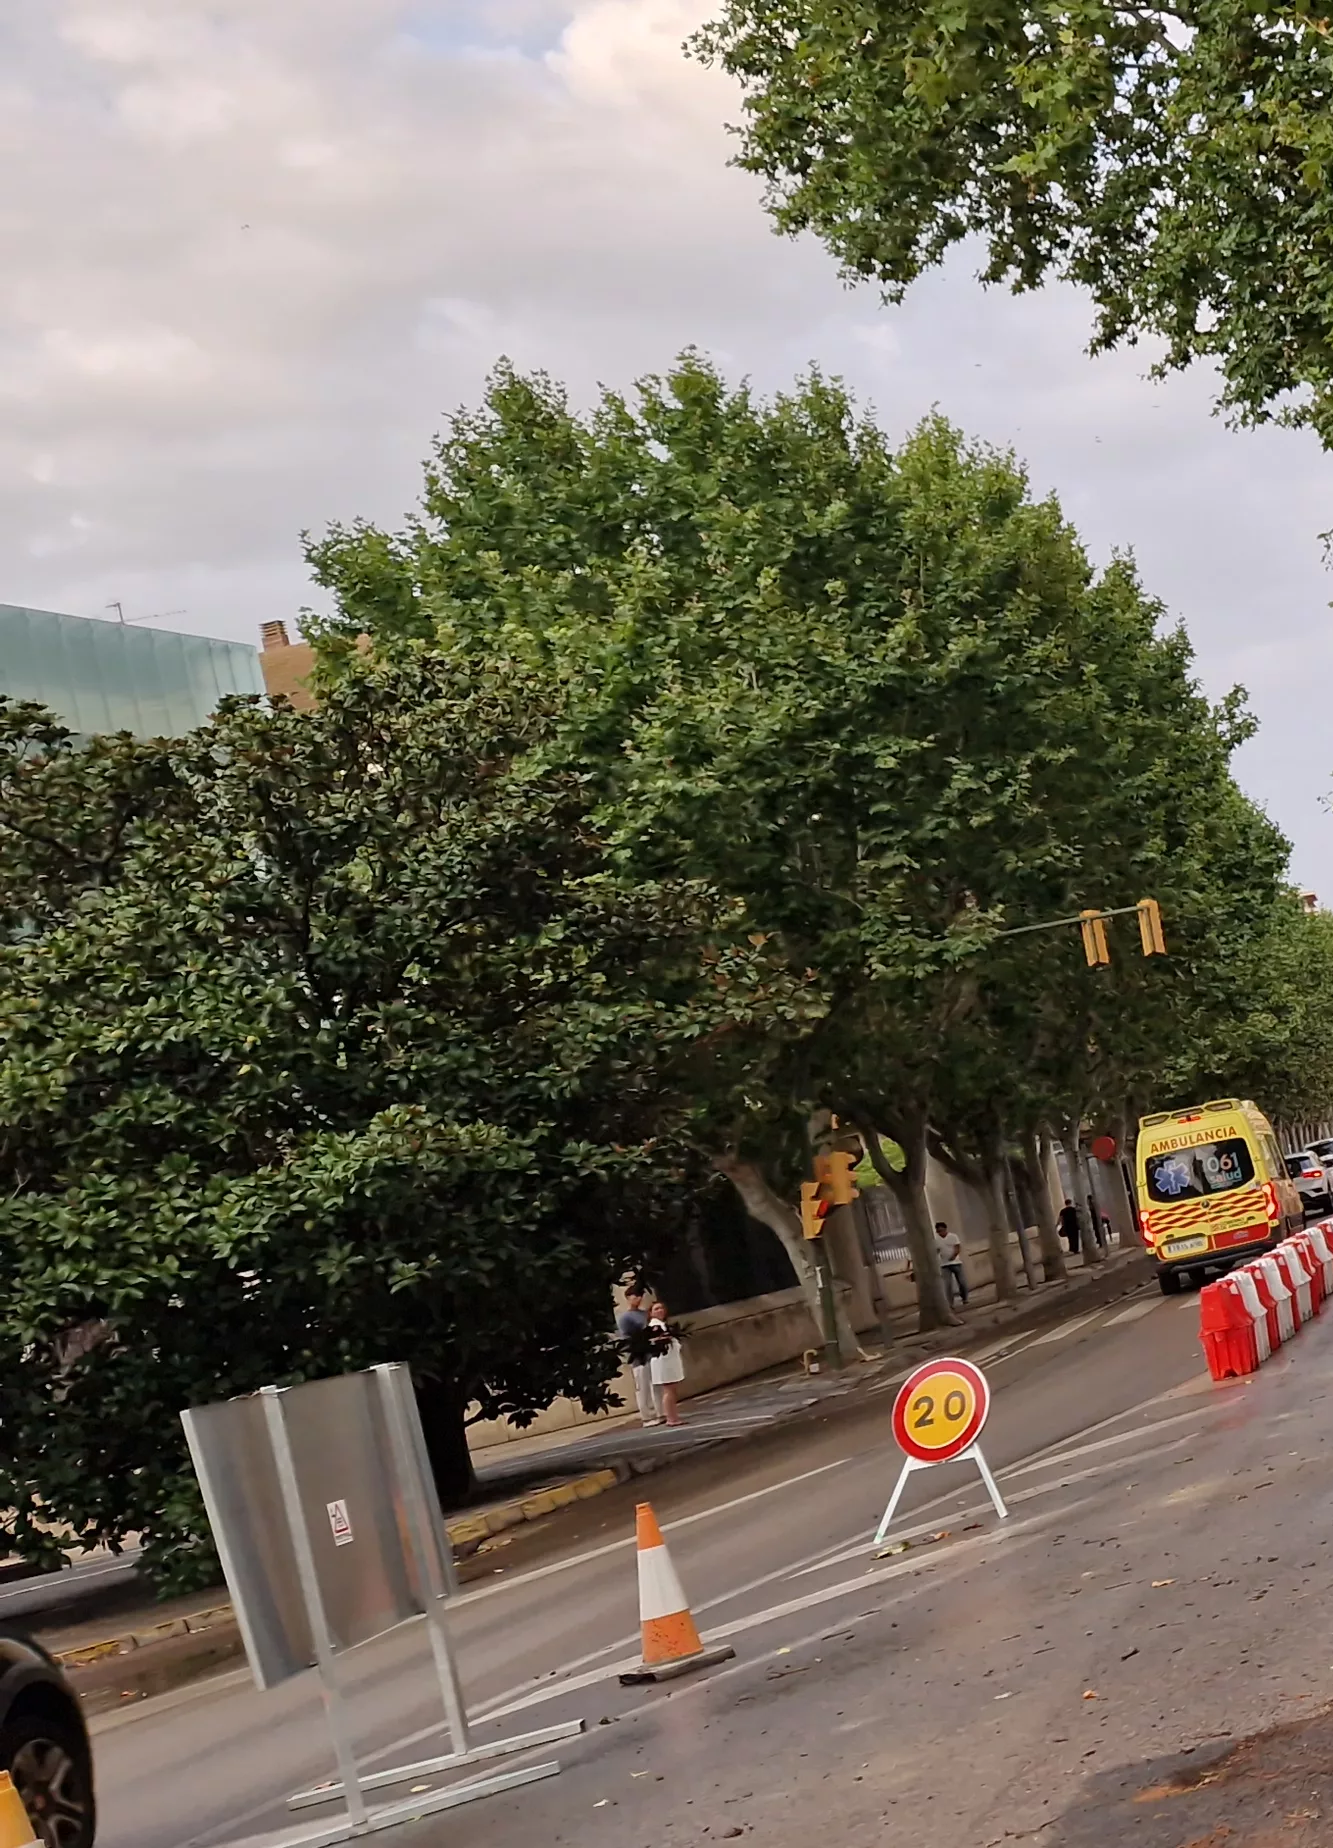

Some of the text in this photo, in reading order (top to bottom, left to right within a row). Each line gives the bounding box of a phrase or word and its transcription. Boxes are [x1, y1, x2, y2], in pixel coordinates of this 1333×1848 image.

[1150, 1126, 1237, 1154] AMBULANCIA
[1206, 1151, 1239, 1173] 061
[1209, 1167, 1242, 1184] salud
[913, 1390, 966, 1429] 20
